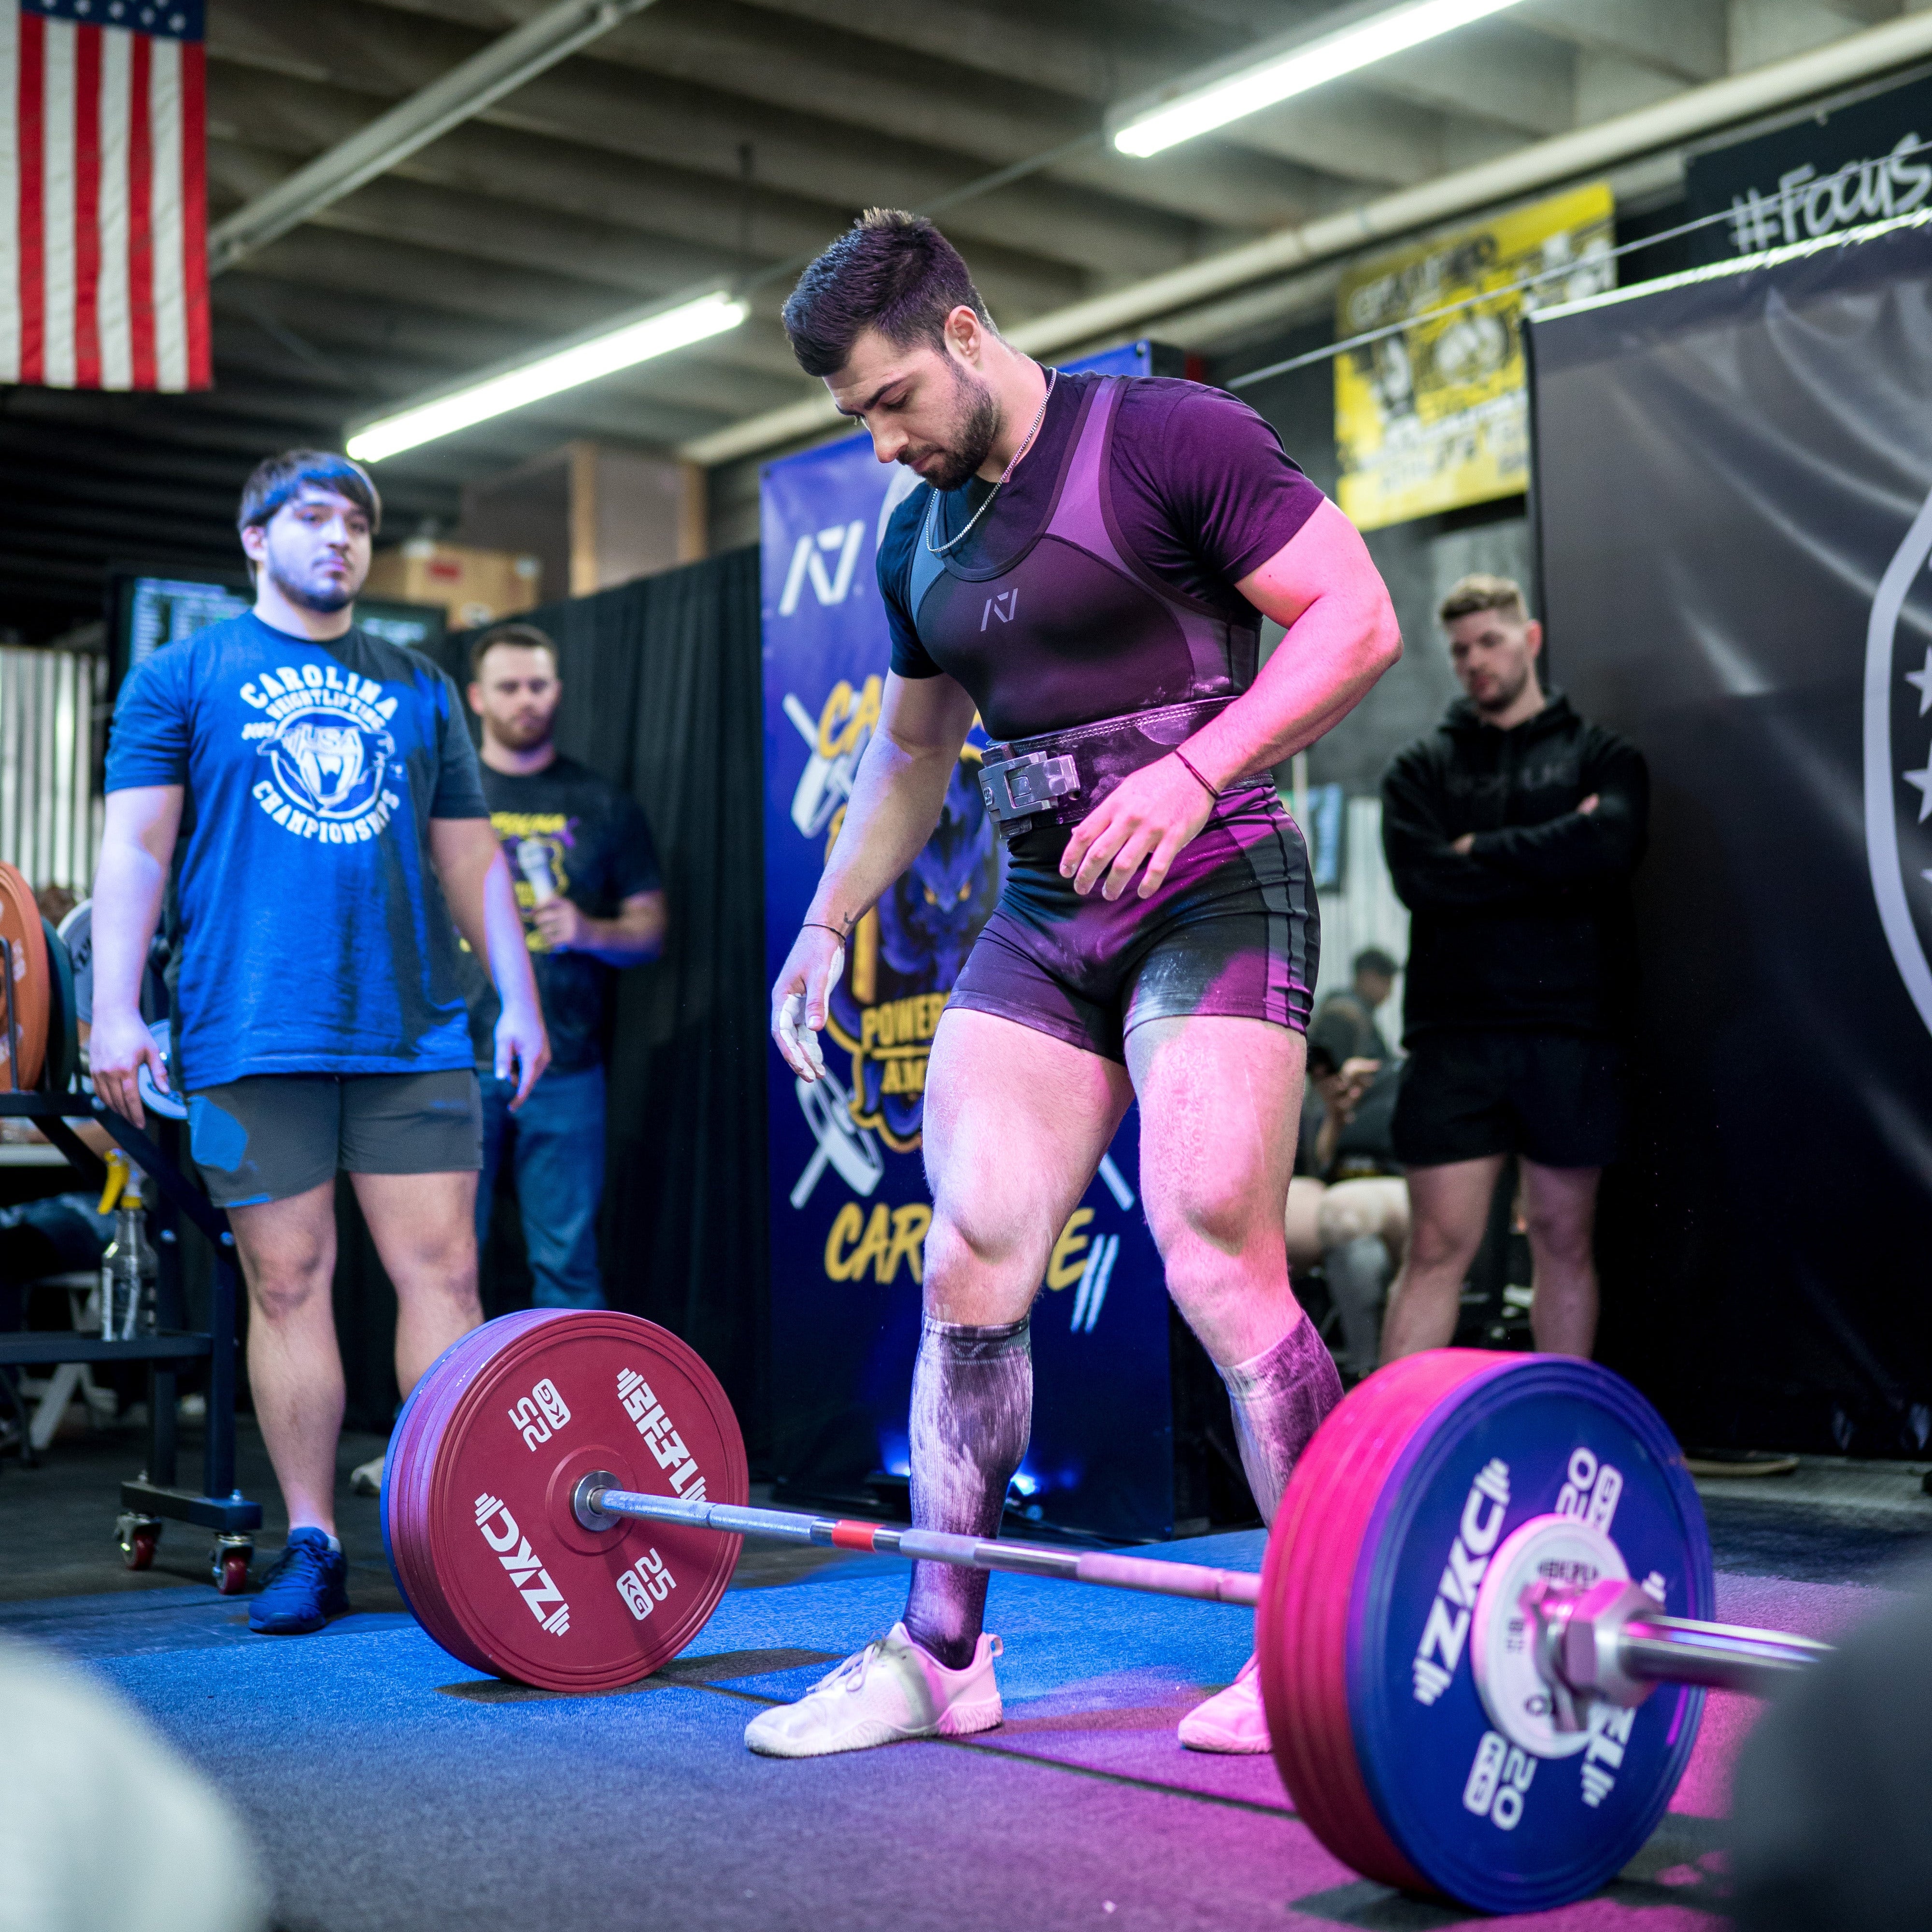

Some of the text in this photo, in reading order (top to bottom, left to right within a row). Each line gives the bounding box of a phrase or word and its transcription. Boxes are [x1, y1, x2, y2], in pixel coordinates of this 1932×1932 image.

[240, 663, 398, 720] CAROLINA
[508, 1397, 553, 1452] 25
[537, 1386, 566, 1422] KG
[1555, 1448, 1597, 1520] 20
[480, 1506, 564, 1623] ZKC
[635, 1548, 676, 1602] 25
[1421, 1489, 1506, 1673] ZKC
[621, 1576, 648, 1613] KG
[1491, 1744, 1537, 1830] 20
